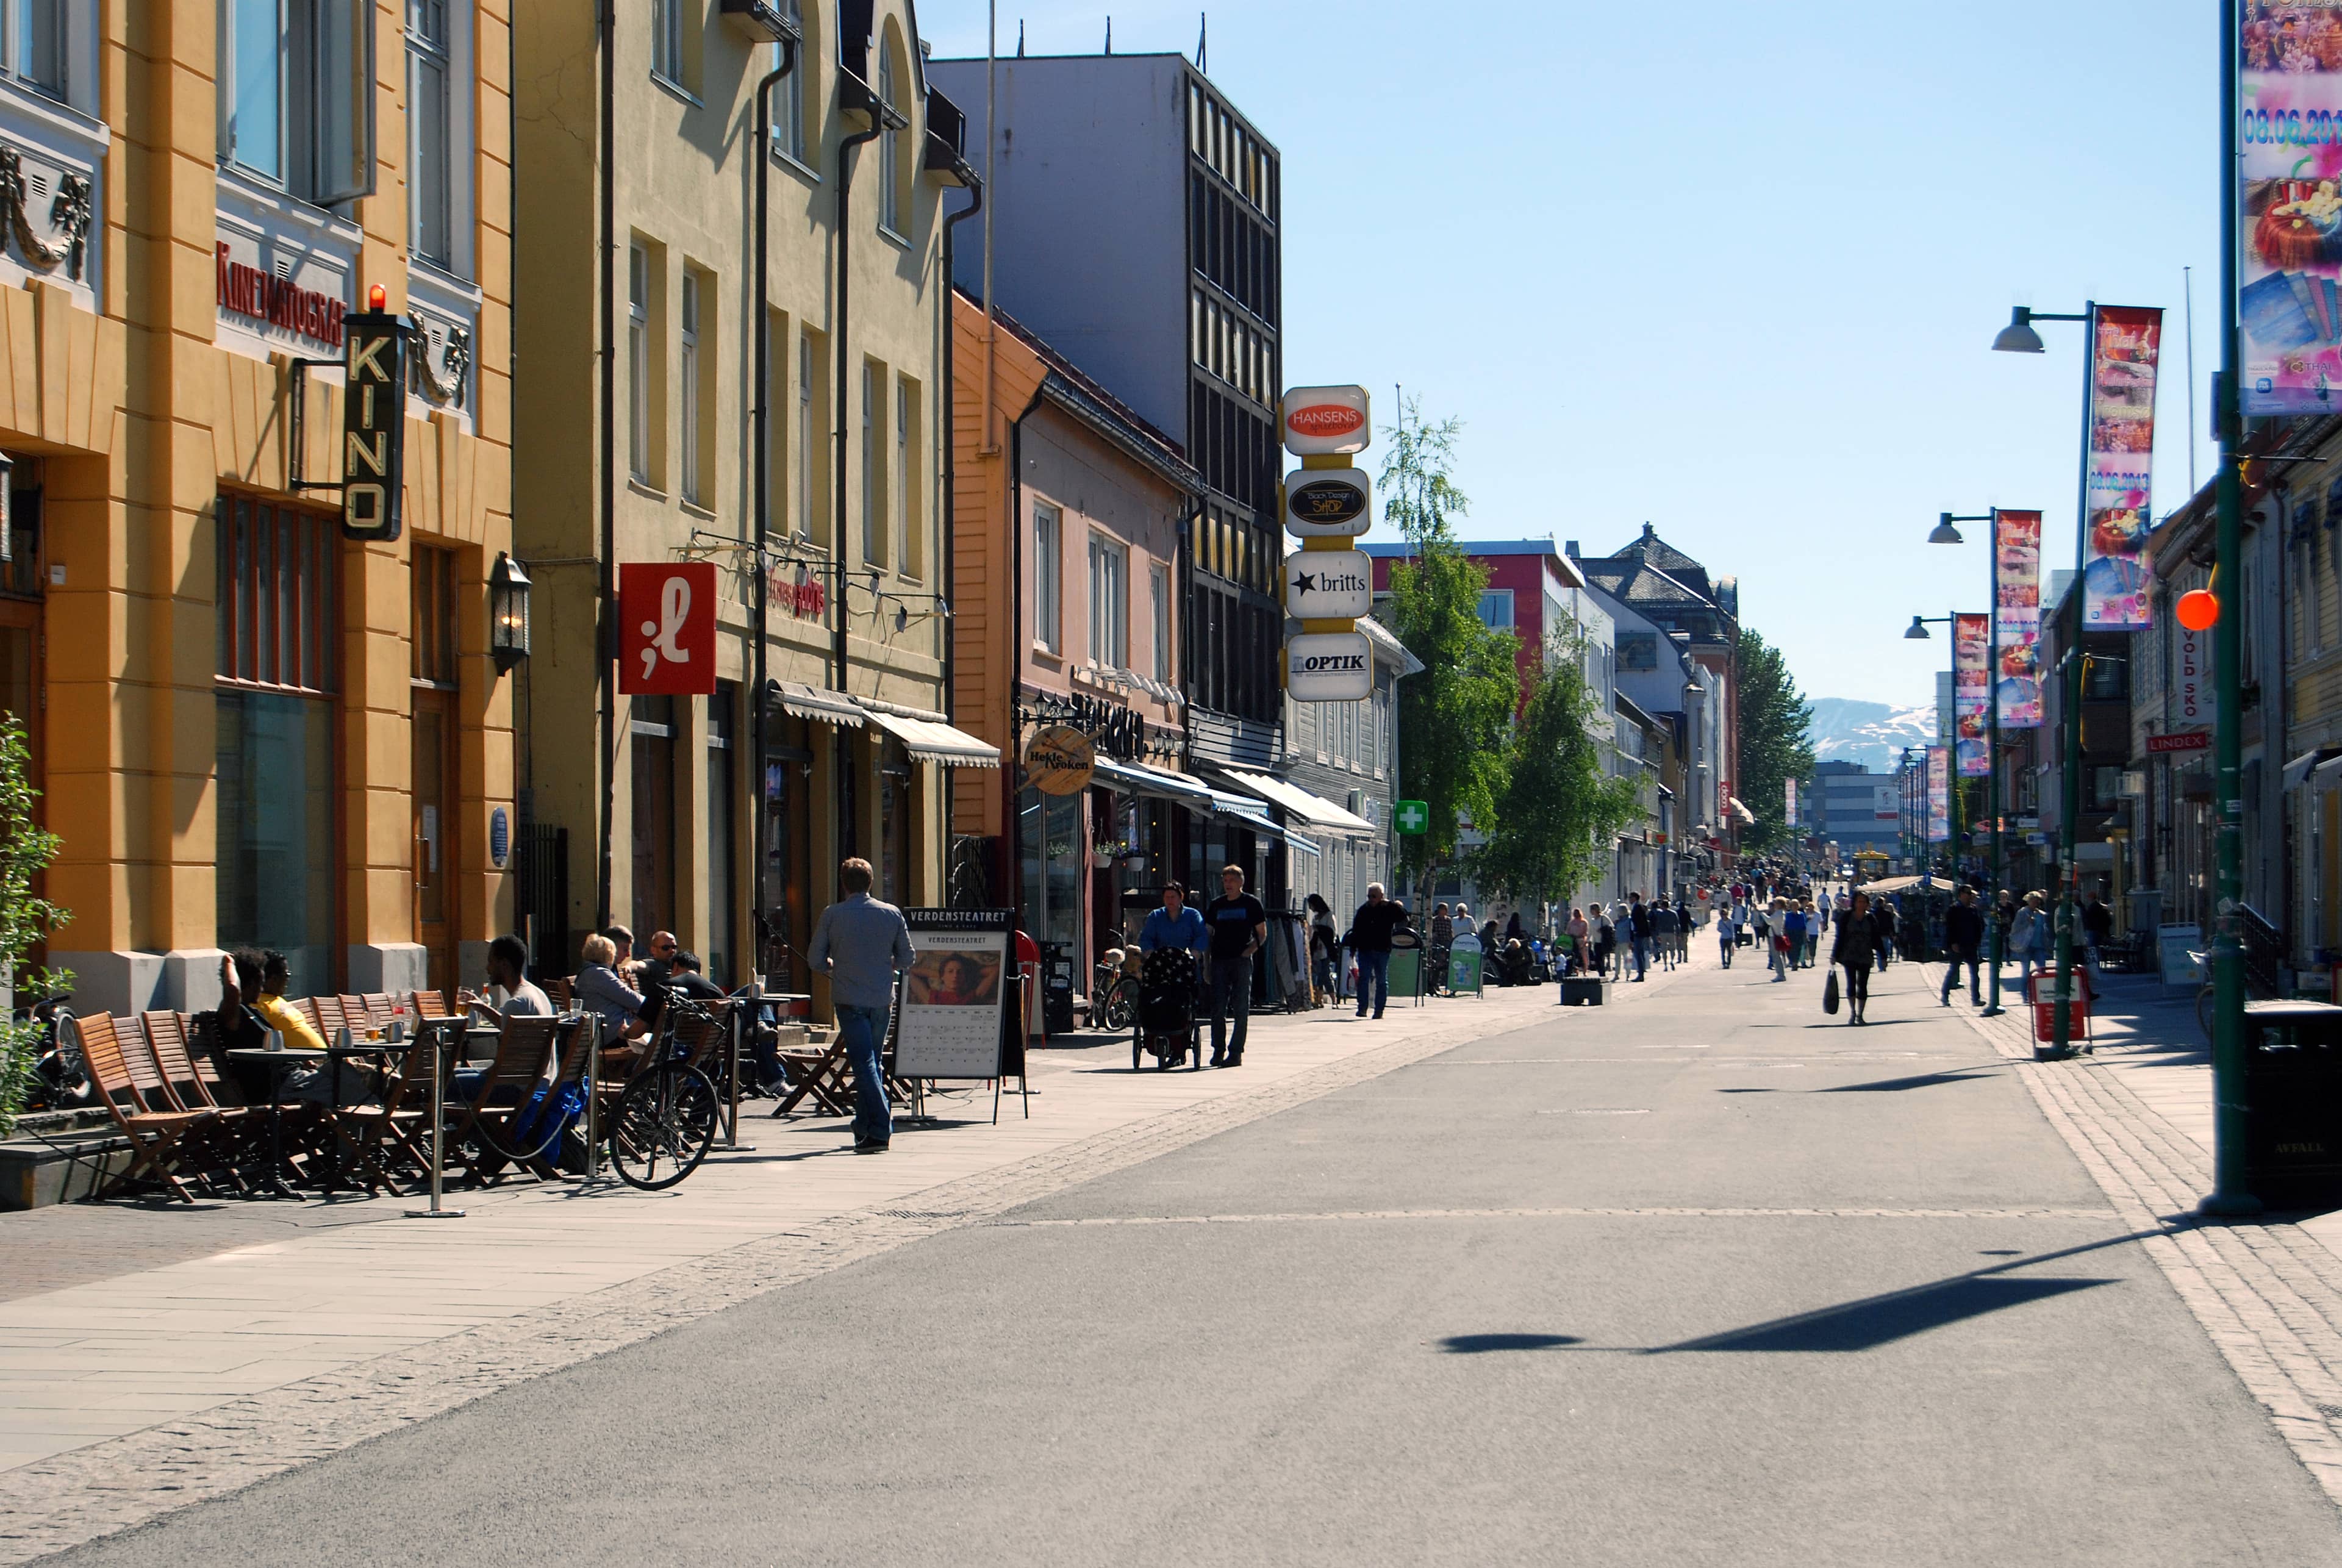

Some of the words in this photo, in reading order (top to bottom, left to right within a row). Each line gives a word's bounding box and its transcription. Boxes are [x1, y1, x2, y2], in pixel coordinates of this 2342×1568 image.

[2305, 362, 2332, 371] THAI
[1294, 410, 1357, 424] HANSENS
[345, 336, 391, 528] KINO
[1312, 498, 1343, 517] SHOP
[1321, 571, 1366, 592] britts
[1305, 655, 1364, 670] OPTIK
[2183, 683, 2197, 717] SKO
[2150, 735, 2202, 751] LINDEX
[911, 911, 1006, 922] VERDENSTEATRET
